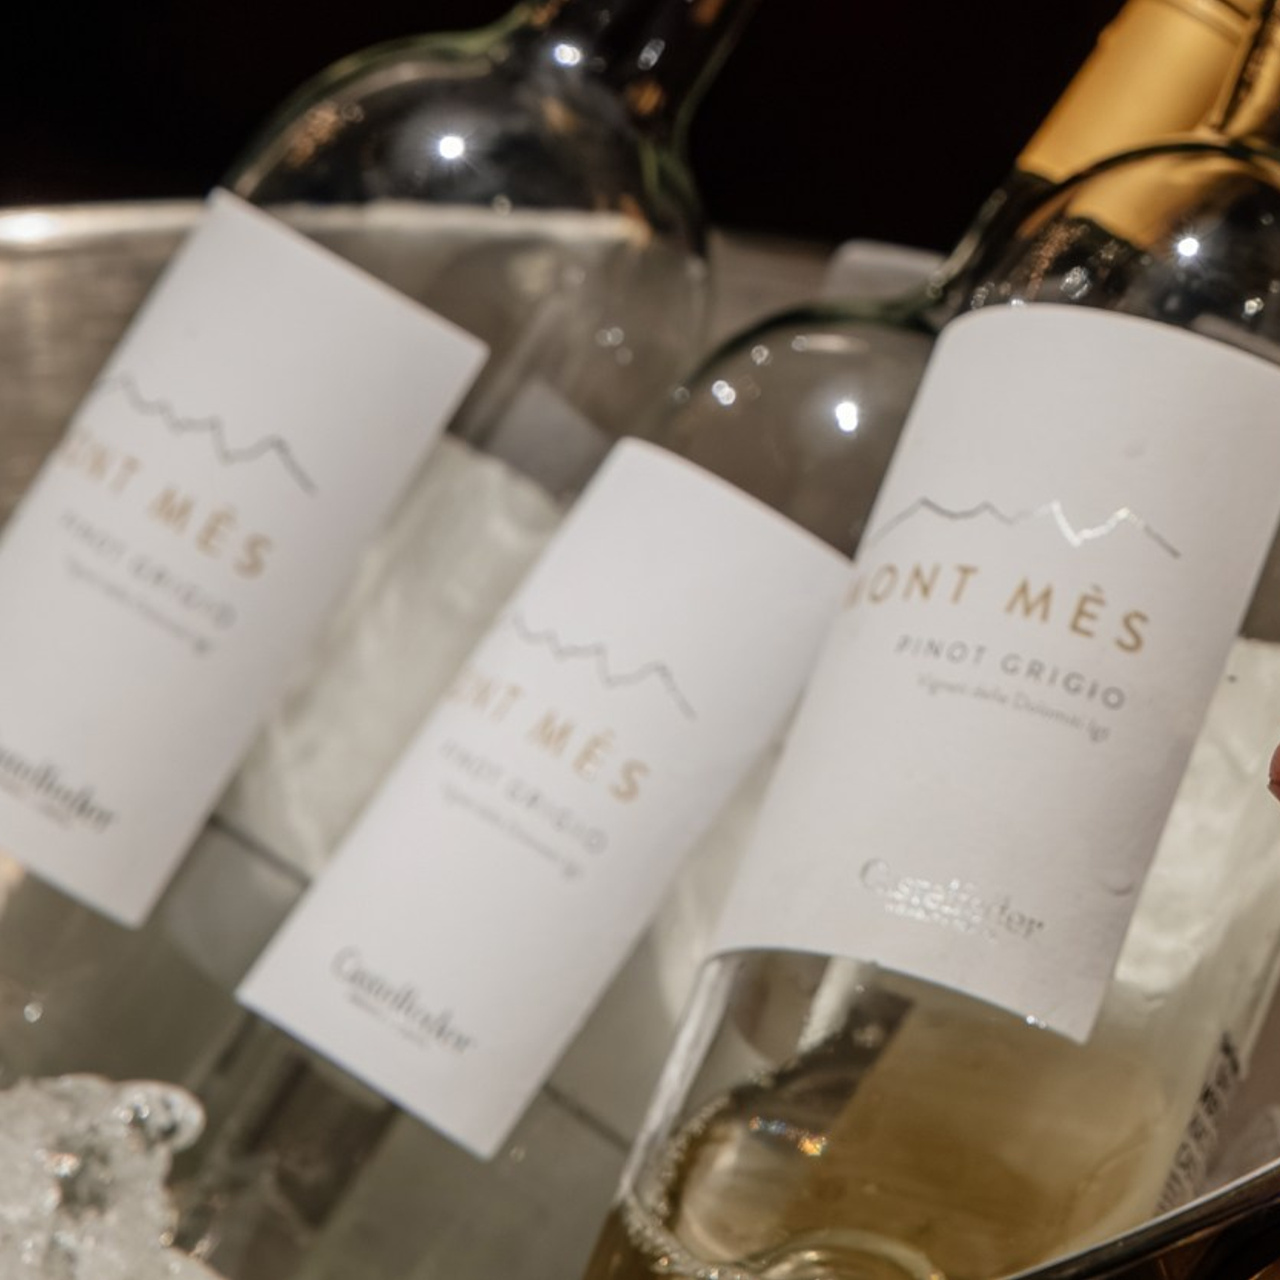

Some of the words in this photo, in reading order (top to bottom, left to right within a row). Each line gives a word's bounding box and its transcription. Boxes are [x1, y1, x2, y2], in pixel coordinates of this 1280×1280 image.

[1003, 575, 1150, 655] MÈS
[893, 633, 988, 666] PINOT
[999, 652, 1127, 711] GRIGIO
